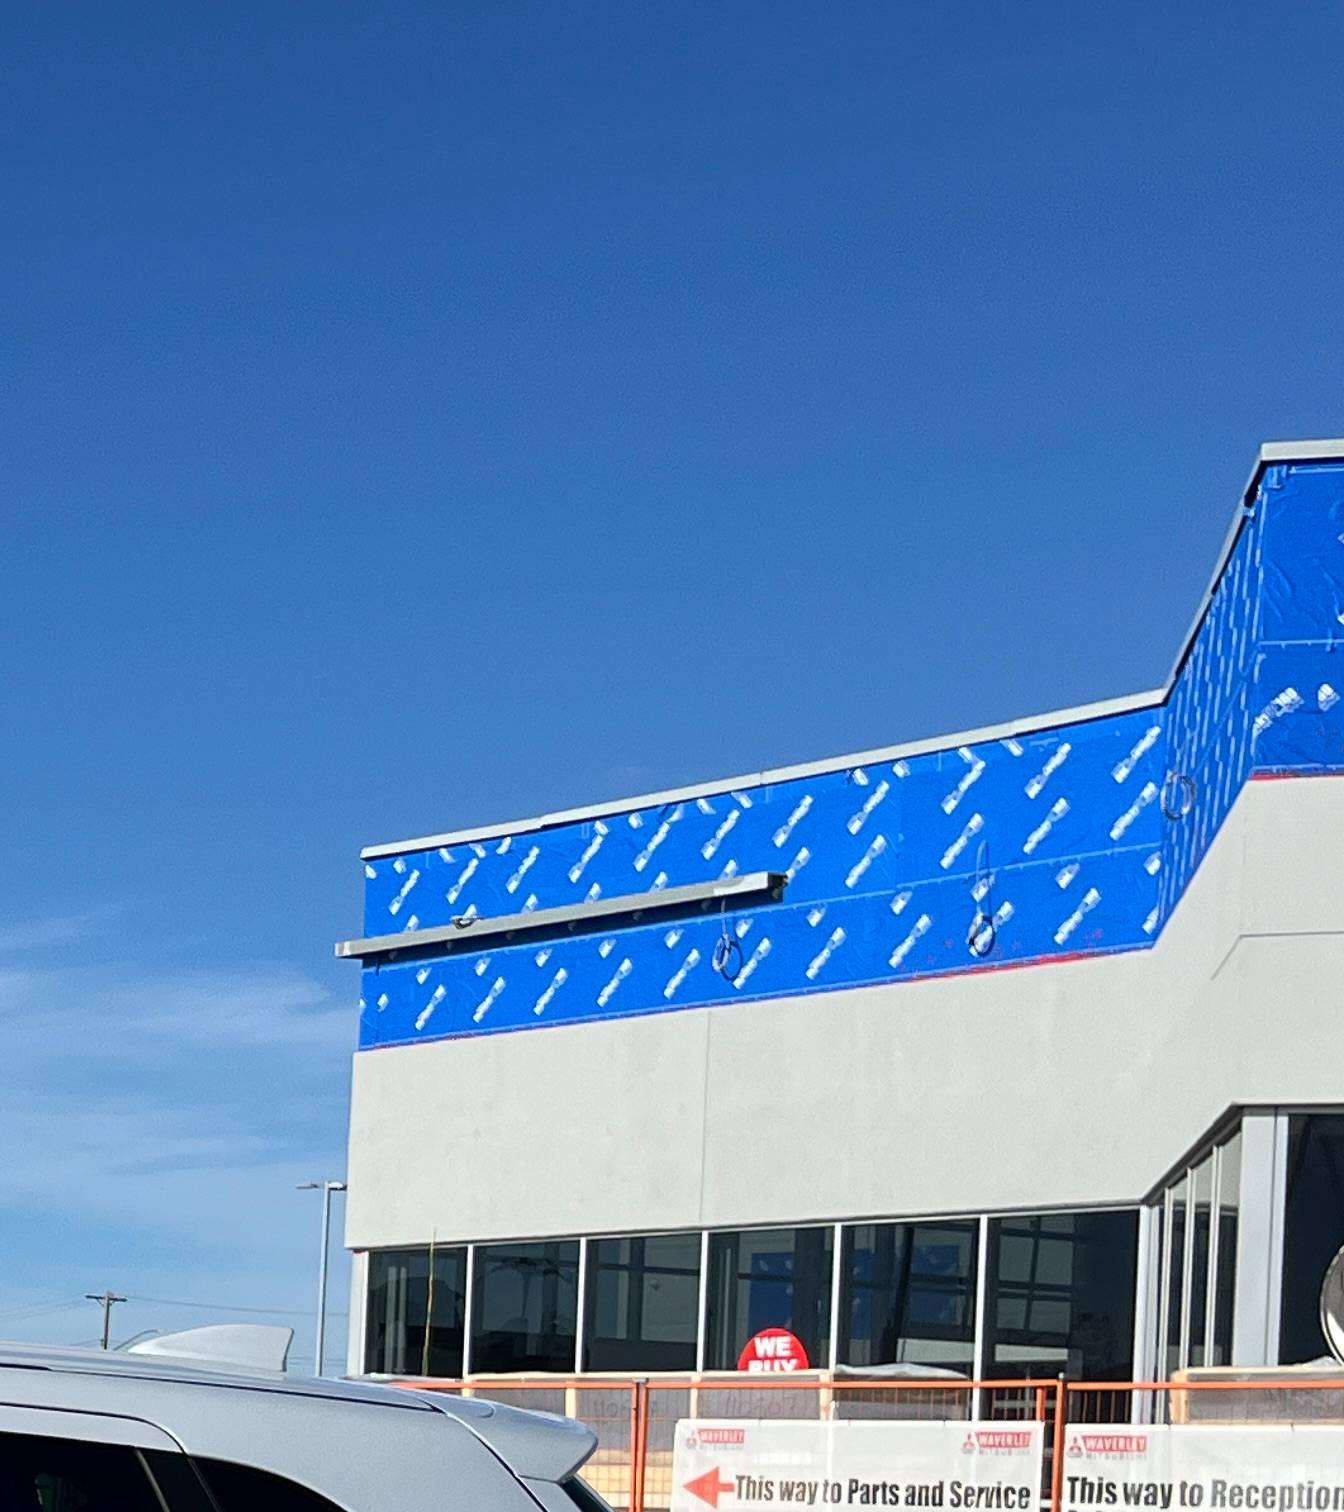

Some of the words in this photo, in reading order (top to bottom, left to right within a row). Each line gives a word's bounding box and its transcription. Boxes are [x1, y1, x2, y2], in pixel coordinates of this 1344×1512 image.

[754, 1335, 792, 1358] WE
[978, 1433, 1030, 1446] WAVERLEY
[1086, 1438, 1146, 1451] WAVERLEY
[736, 1475, 774, 1501] This
[780, 1481, 818, 1505] way
[823, 1480, 842, 1503] to
[848, 1478, 899, 1505] Parts
[905, 1481, 944, 1507] and
[950, 1480, 1031, 1509] Service
[1067, 1476, 1117, 1504] This
[1123, 1482, 1173, 1509] way
[1180, 1481, 1203, 1507] to
[1211, 1479, 1344, 1512] Reception
